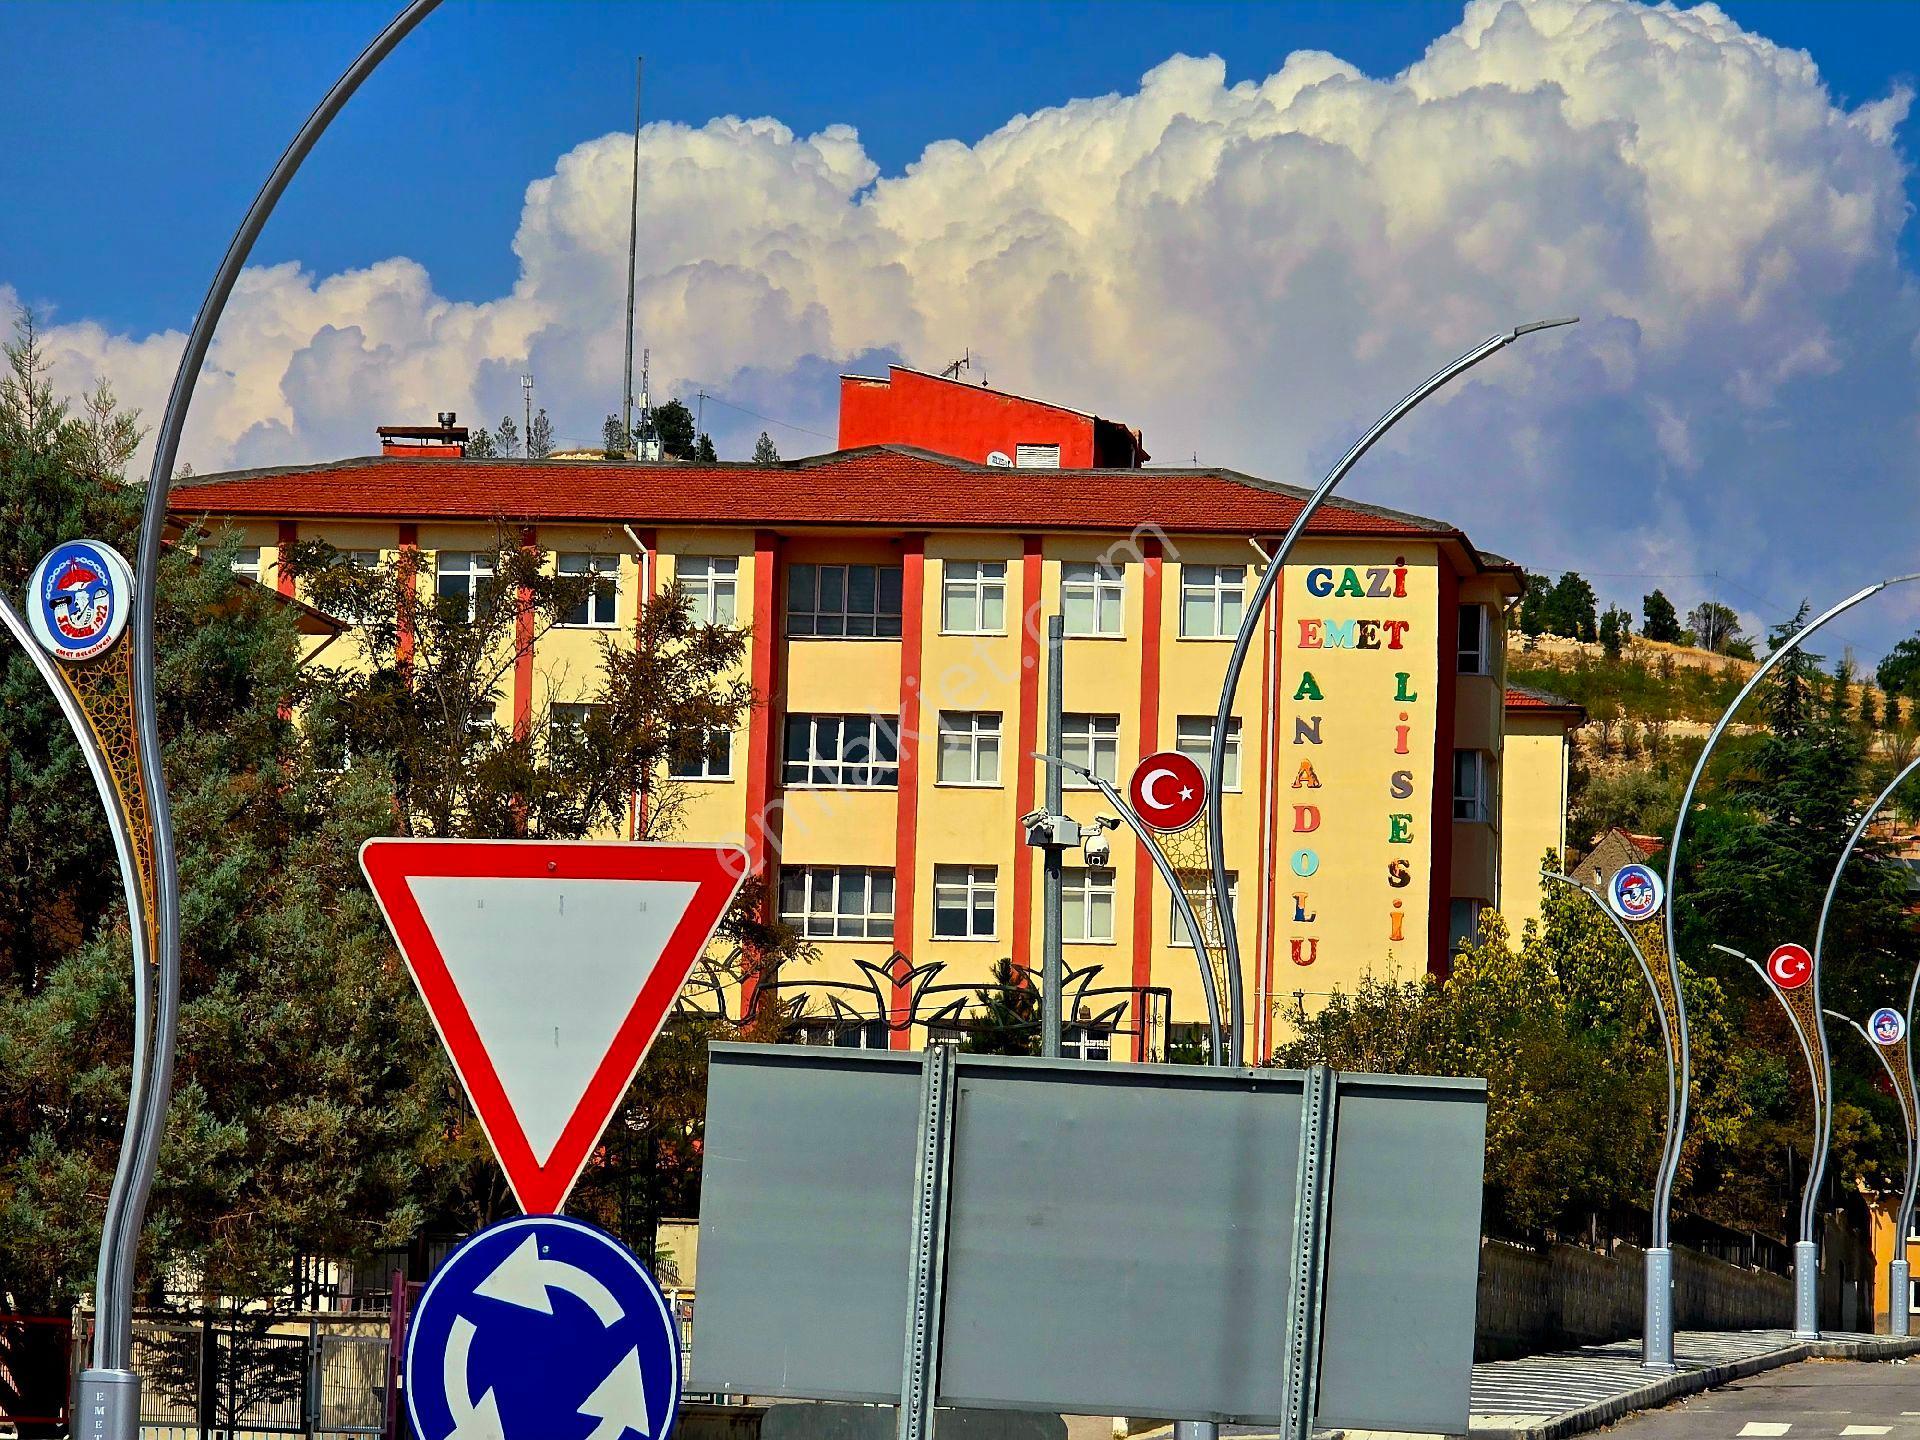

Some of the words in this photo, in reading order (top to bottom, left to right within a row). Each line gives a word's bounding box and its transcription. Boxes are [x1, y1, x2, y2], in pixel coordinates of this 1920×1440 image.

[1306, 556, 1408, 598] GAZİ
[94, 605, 107, 628] 1922
[1297, 619, 1410, 650] EMET
[56, 649, 74, 657] EMET
[1290, 671, 1325, 967] ANADOLU
[1388, 672, 1418, 942] LİSESİ
[94, 1392, 105, 1440] EMET
